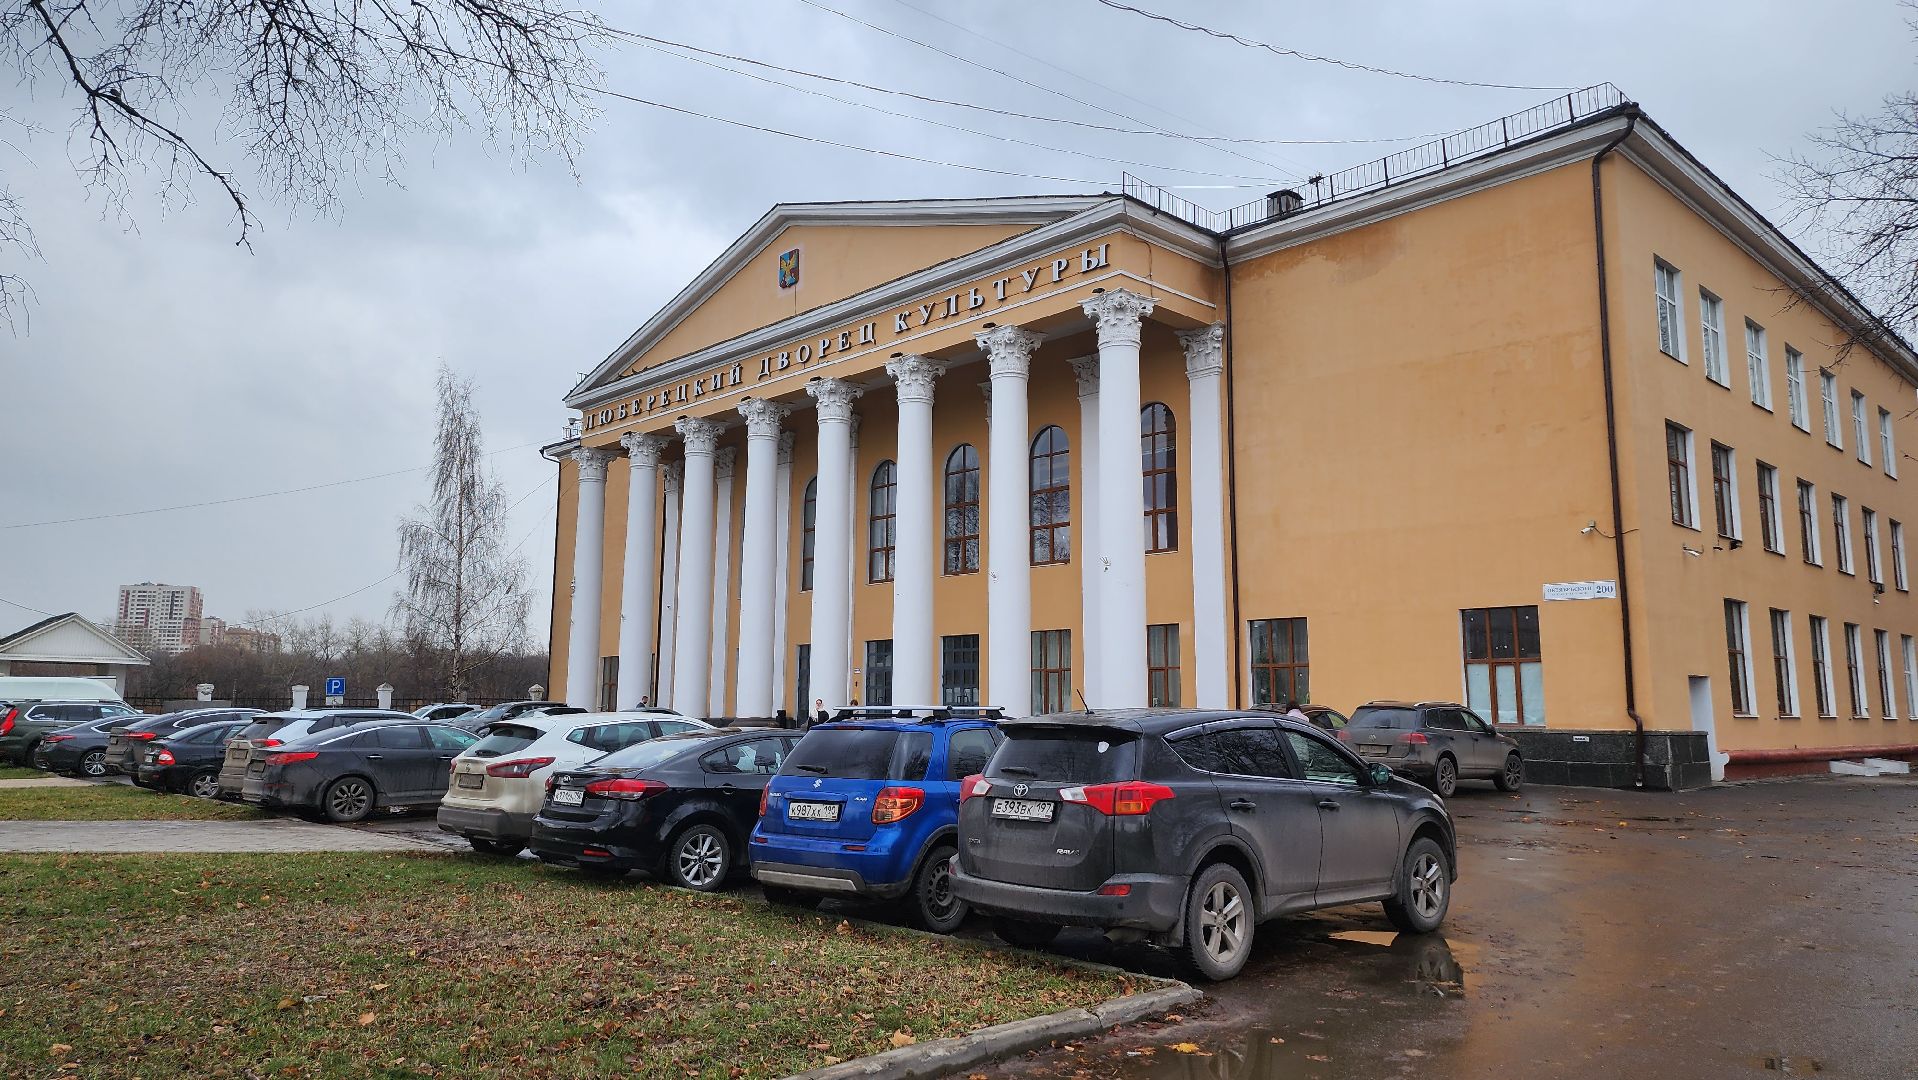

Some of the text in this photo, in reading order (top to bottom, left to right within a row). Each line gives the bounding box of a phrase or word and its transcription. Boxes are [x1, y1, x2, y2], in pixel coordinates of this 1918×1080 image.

[584, 243, 1110, 430] ЛЮБЕРЕЦКИЙ ДВОРЕЦ КУЛЬТУРЫ
[1596, 585, 1613, 593] 200
[331, 680, 340, 693] P
[1037, 803, 1052, 814] 197
